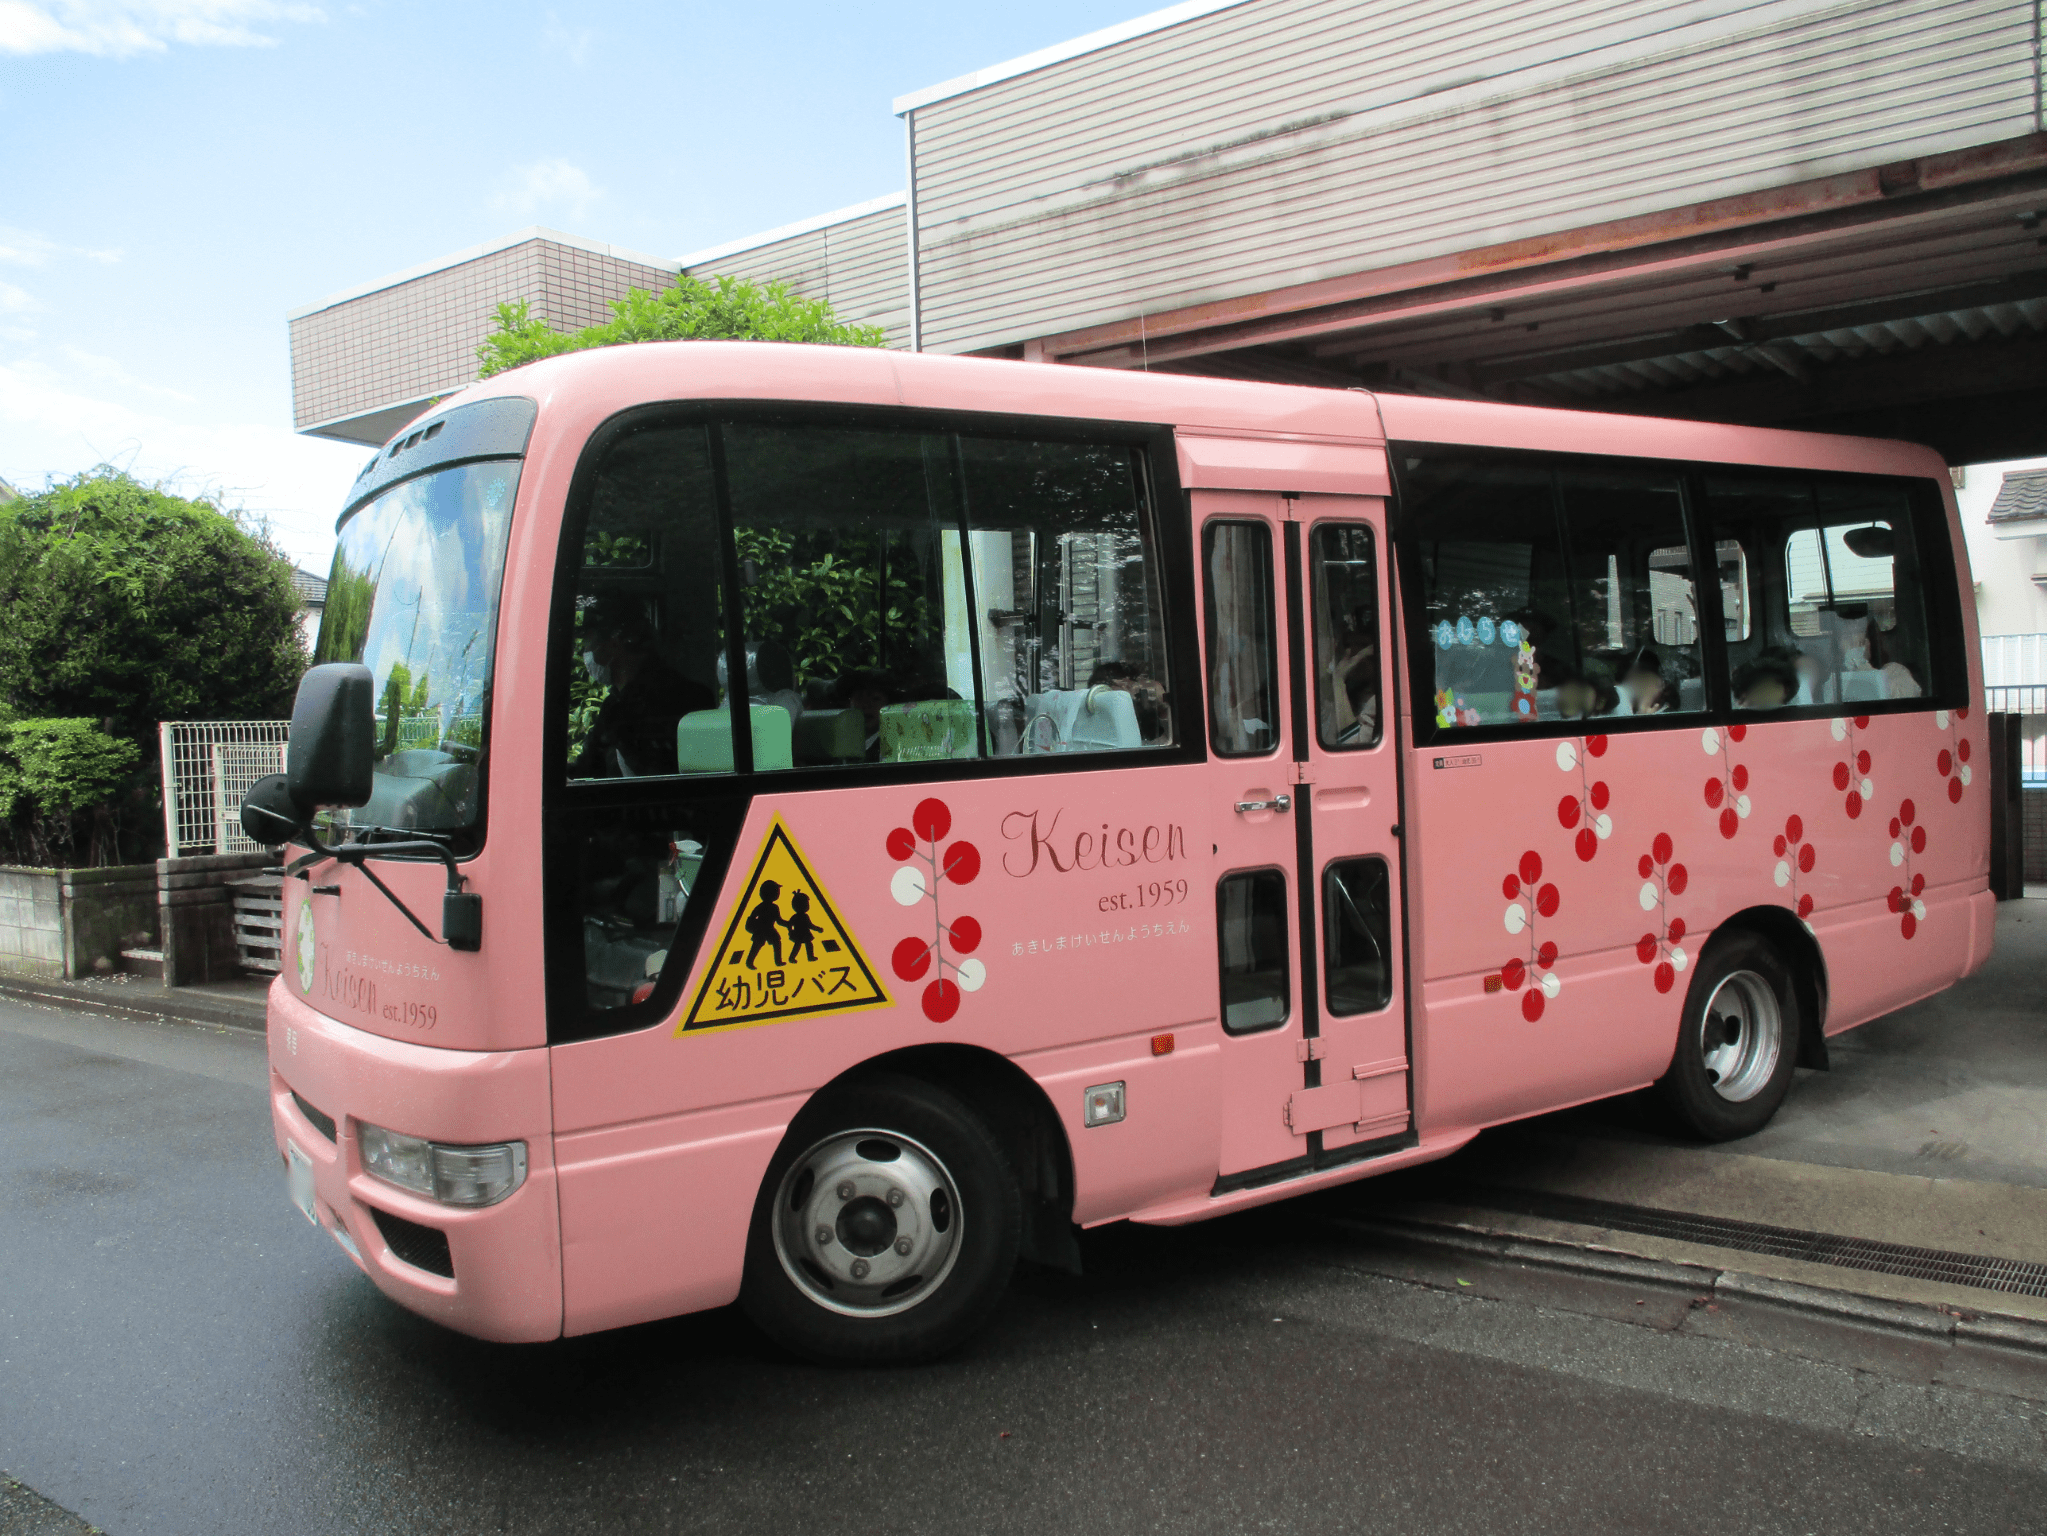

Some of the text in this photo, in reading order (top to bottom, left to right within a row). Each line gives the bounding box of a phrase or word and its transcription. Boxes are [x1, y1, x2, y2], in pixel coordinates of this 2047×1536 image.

[1001, 807, 1188, 878] Keisen
[1098, 879, 1189, 912] est.1959
[1011, 920, 1190, 956] あきしまけいせんようちえん
[715, 966, 858, 1011] 幼児バス
[382, 1002, 438, 1030] est.1959
